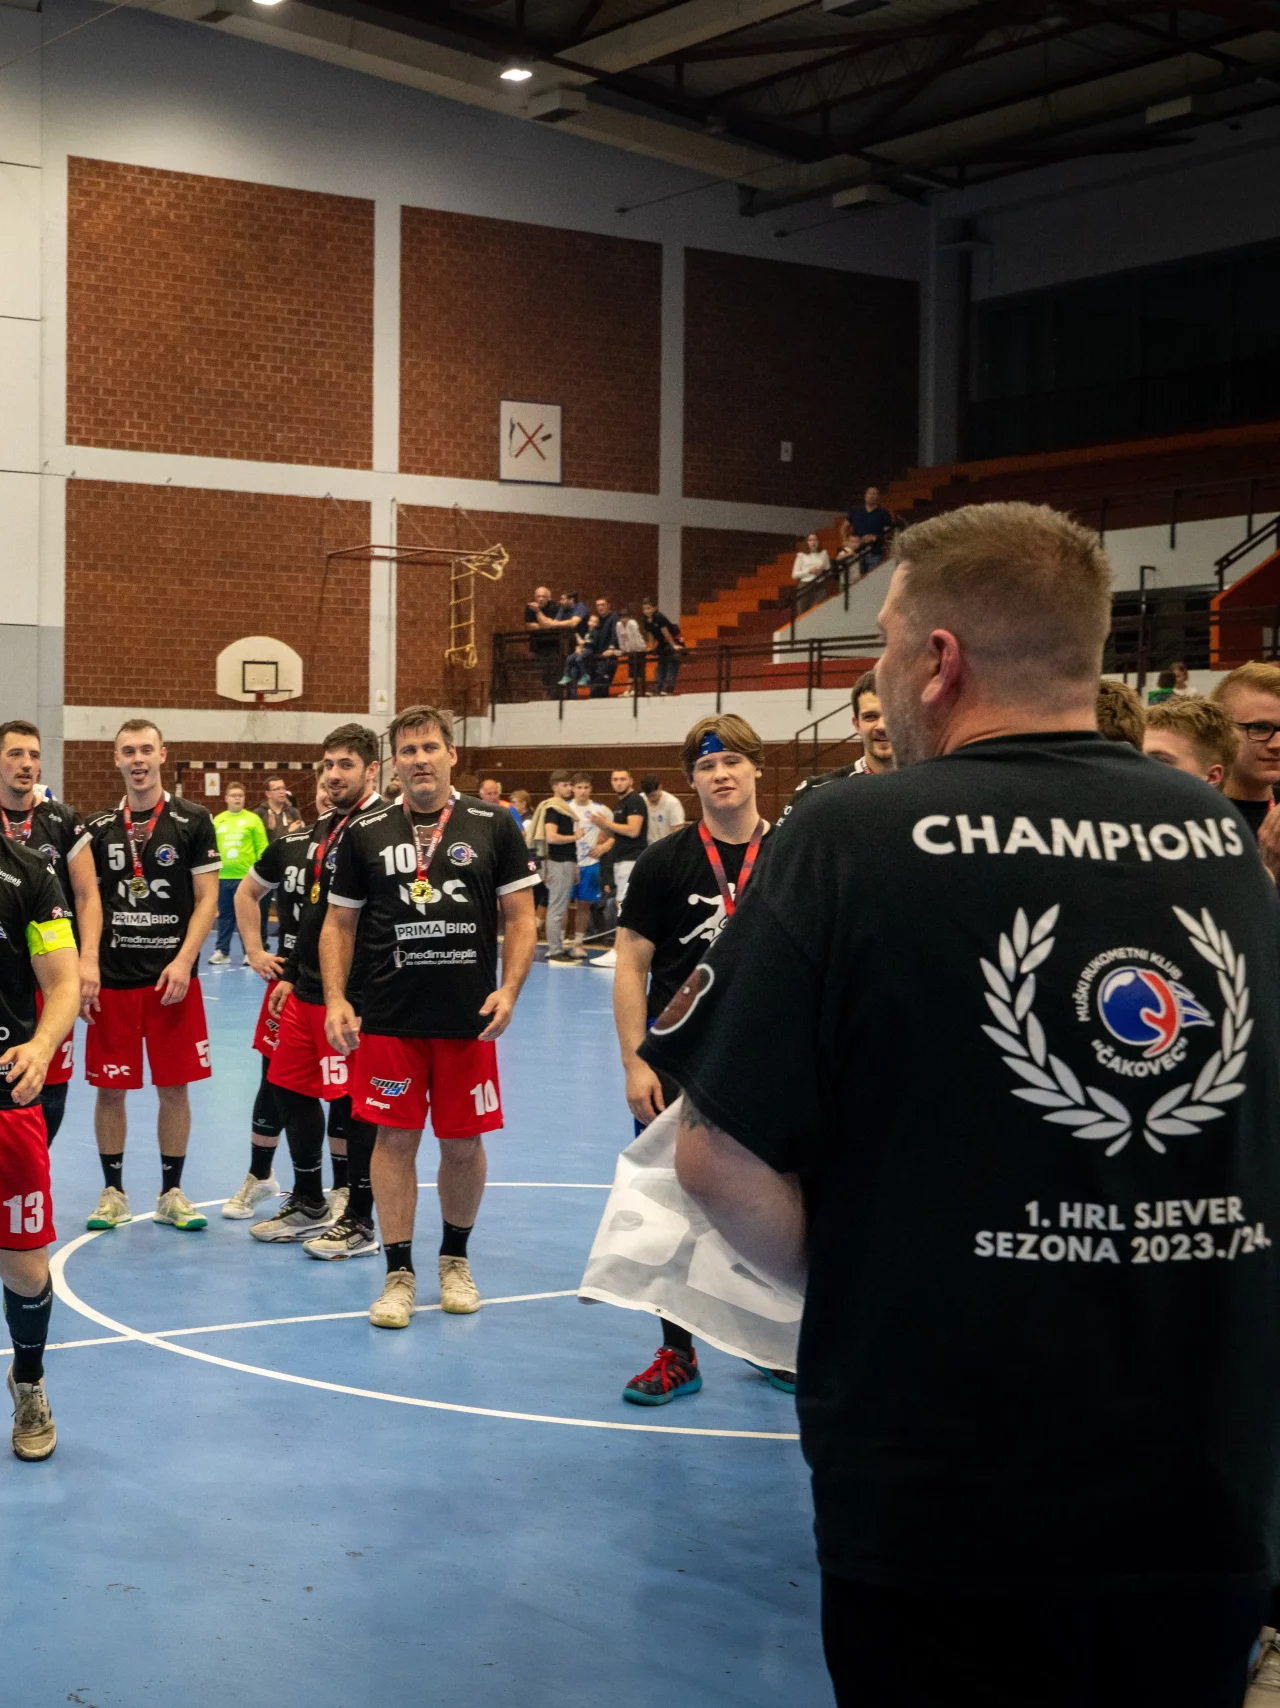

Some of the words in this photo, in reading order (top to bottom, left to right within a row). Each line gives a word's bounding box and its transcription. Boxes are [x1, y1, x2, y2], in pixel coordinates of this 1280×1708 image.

[912, 814, 1244, 862] CHAMPIONS
[108, 843, 126, 871] 5
[379, 843, 417, 876] 10
[115, 913, 149, 924] PRIMA
[151, 914, 179, 924] BIRO
[397, 923, 443, 938] PRIMA
[446, 922, 477, 934] BIRO
[1080, 947, 1149, 982] RUKOMETNI
[1149, 952, 1183, 981] KLUB
[1072, 979, 1091, 1022] MUŠKI
[195, 1039, 211, 1068] 5
[319, 1056, 348, 1085] 15
[469, 1079, 499, 1116] 10
[2, 1191, 44, 1234] 13
[1025, 1200, 1051, 1228] 1.
[1059, 1201, 1127, 1231] HRL
[1133, 1195, 1246, 1230] SJEVER
[973, 1230, 1121, 1265] SEZONA
